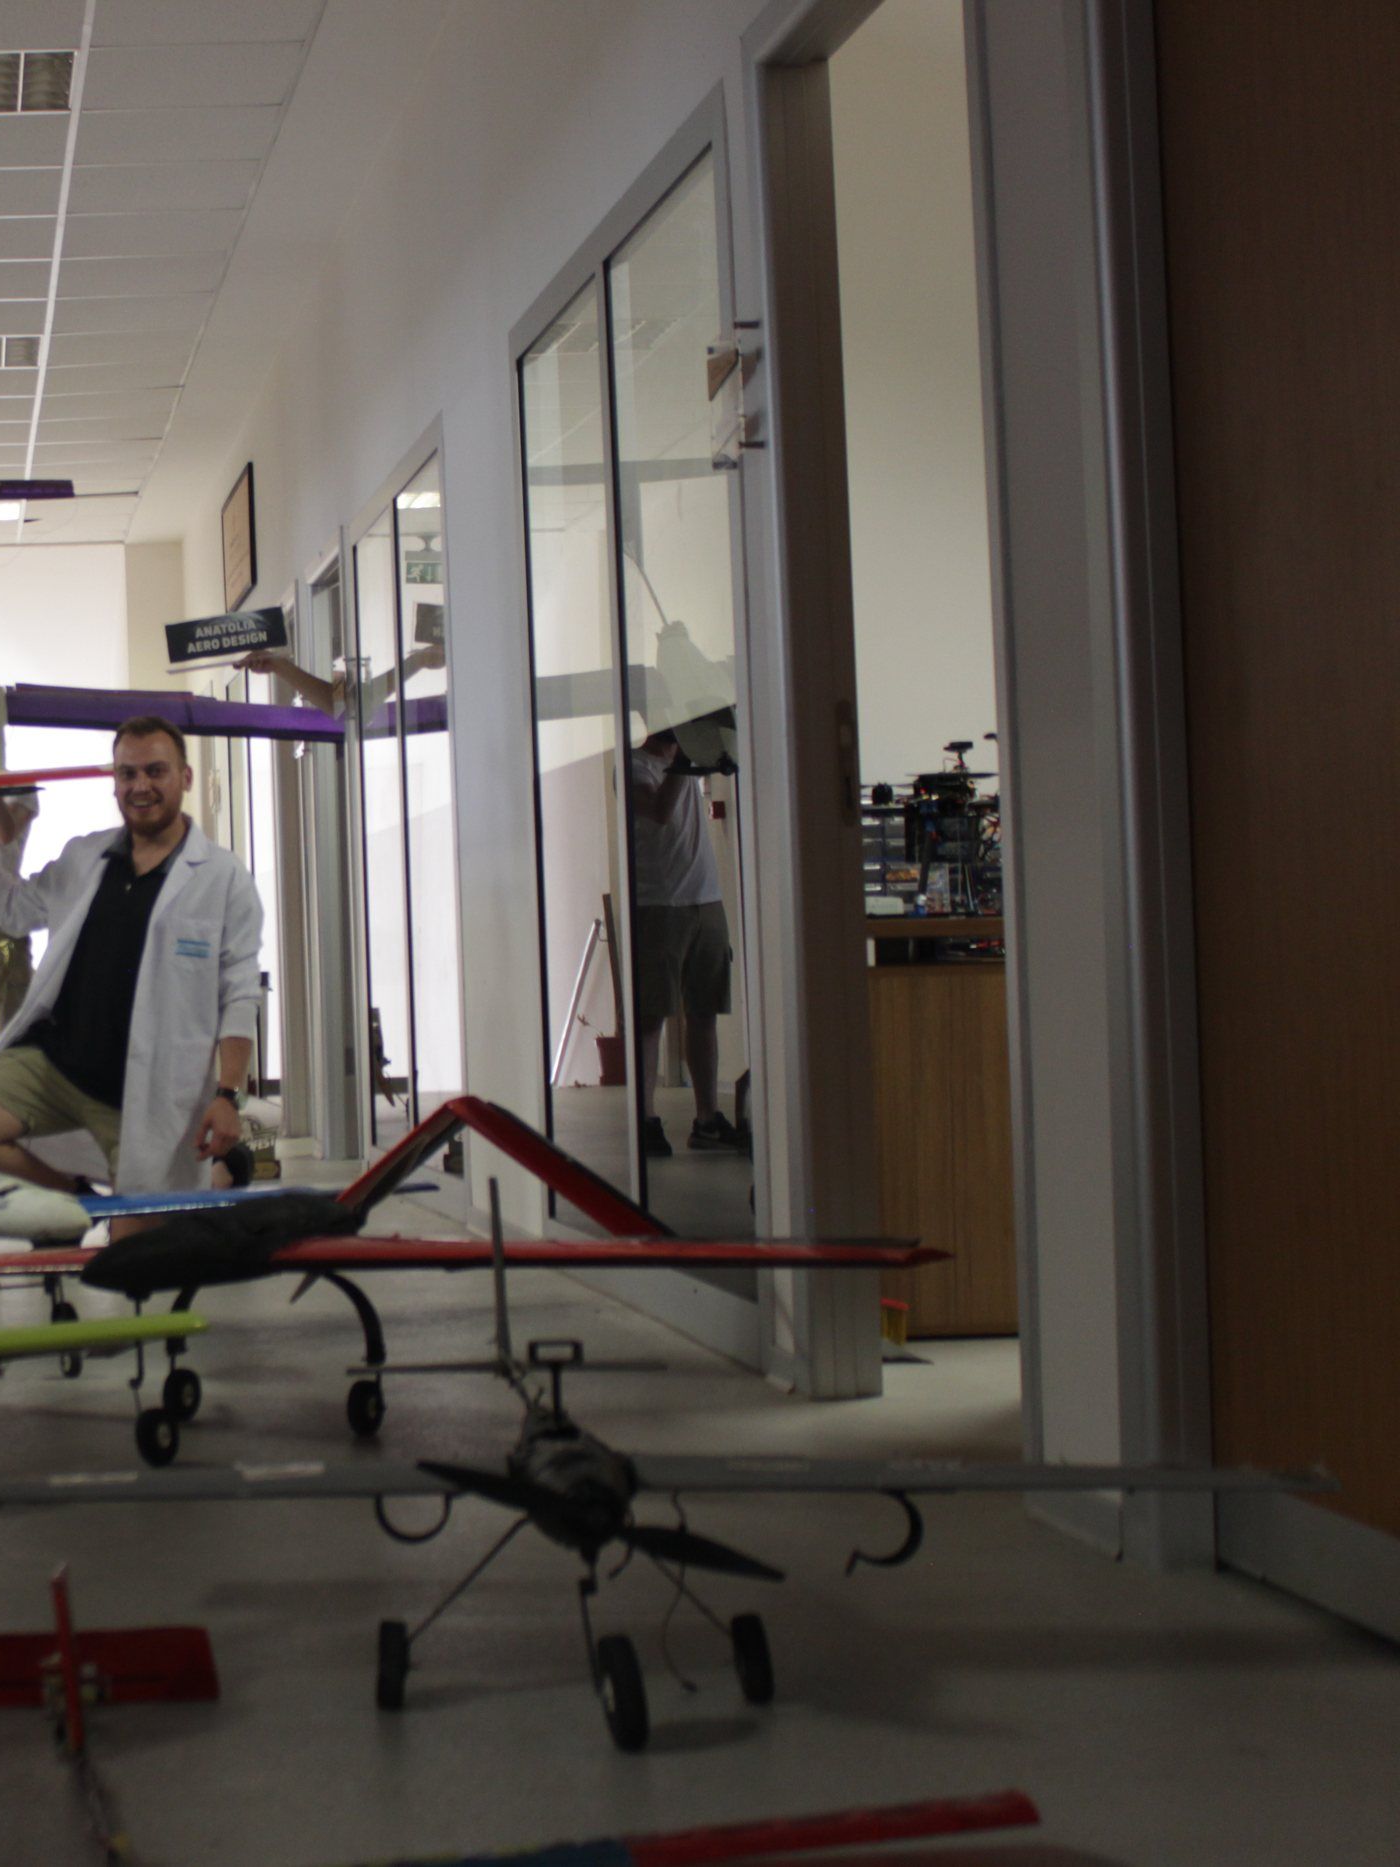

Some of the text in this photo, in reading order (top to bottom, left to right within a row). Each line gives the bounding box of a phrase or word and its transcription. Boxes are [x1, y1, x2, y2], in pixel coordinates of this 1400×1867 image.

[195, 620, 257, 639] ANATOLIA
[187, 630, 268, 654] AERO DESIGN
